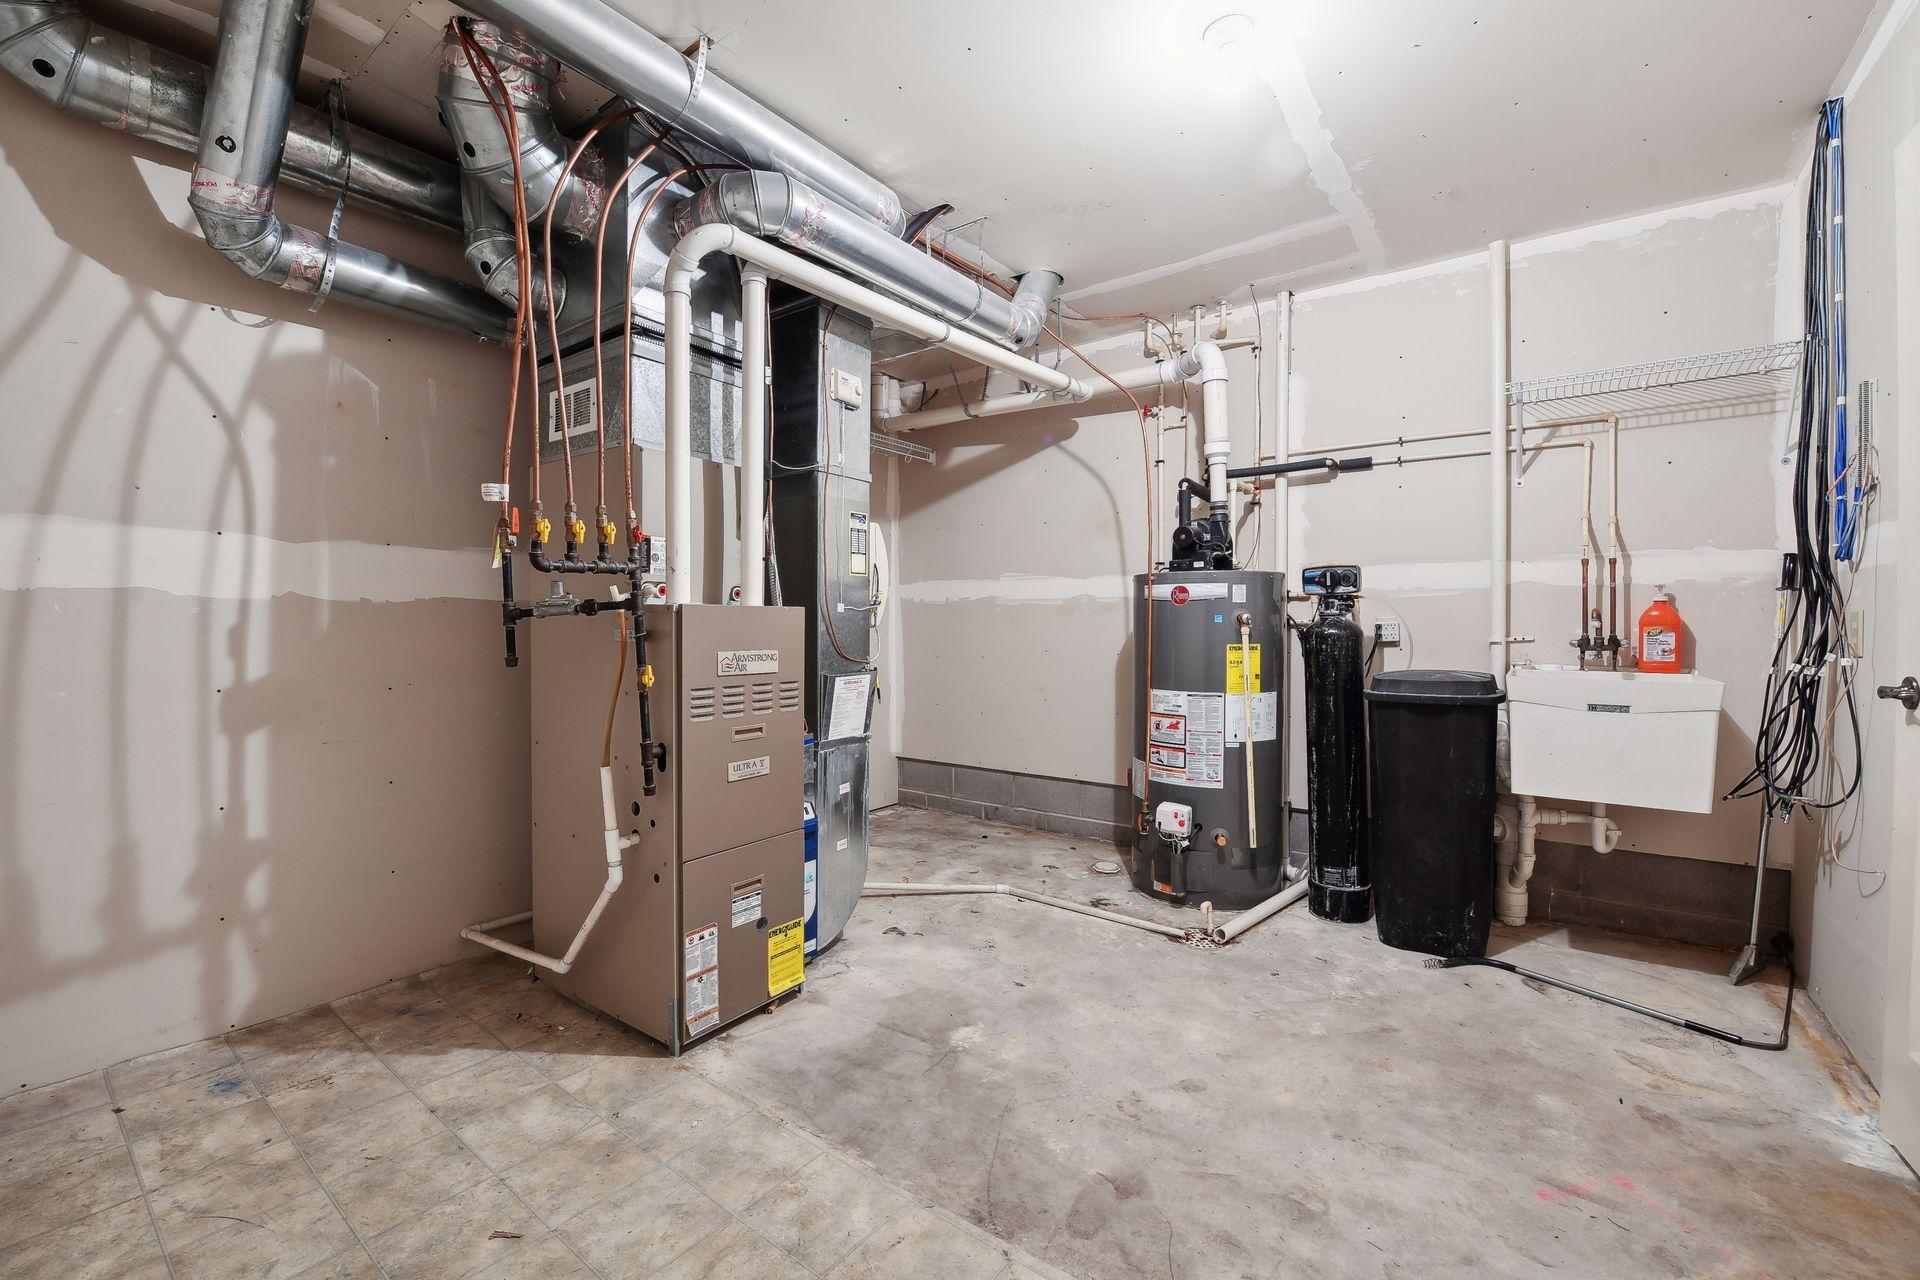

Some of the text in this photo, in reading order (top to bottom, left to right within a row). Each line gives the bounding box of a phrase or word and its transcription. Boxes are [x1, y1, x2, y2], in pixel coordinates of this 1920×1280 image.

[730, 653, 778, 663] ARMSTRONG
[734, 662, 748, 672] AIR
[733, 761, 757, 772] ULTRA
